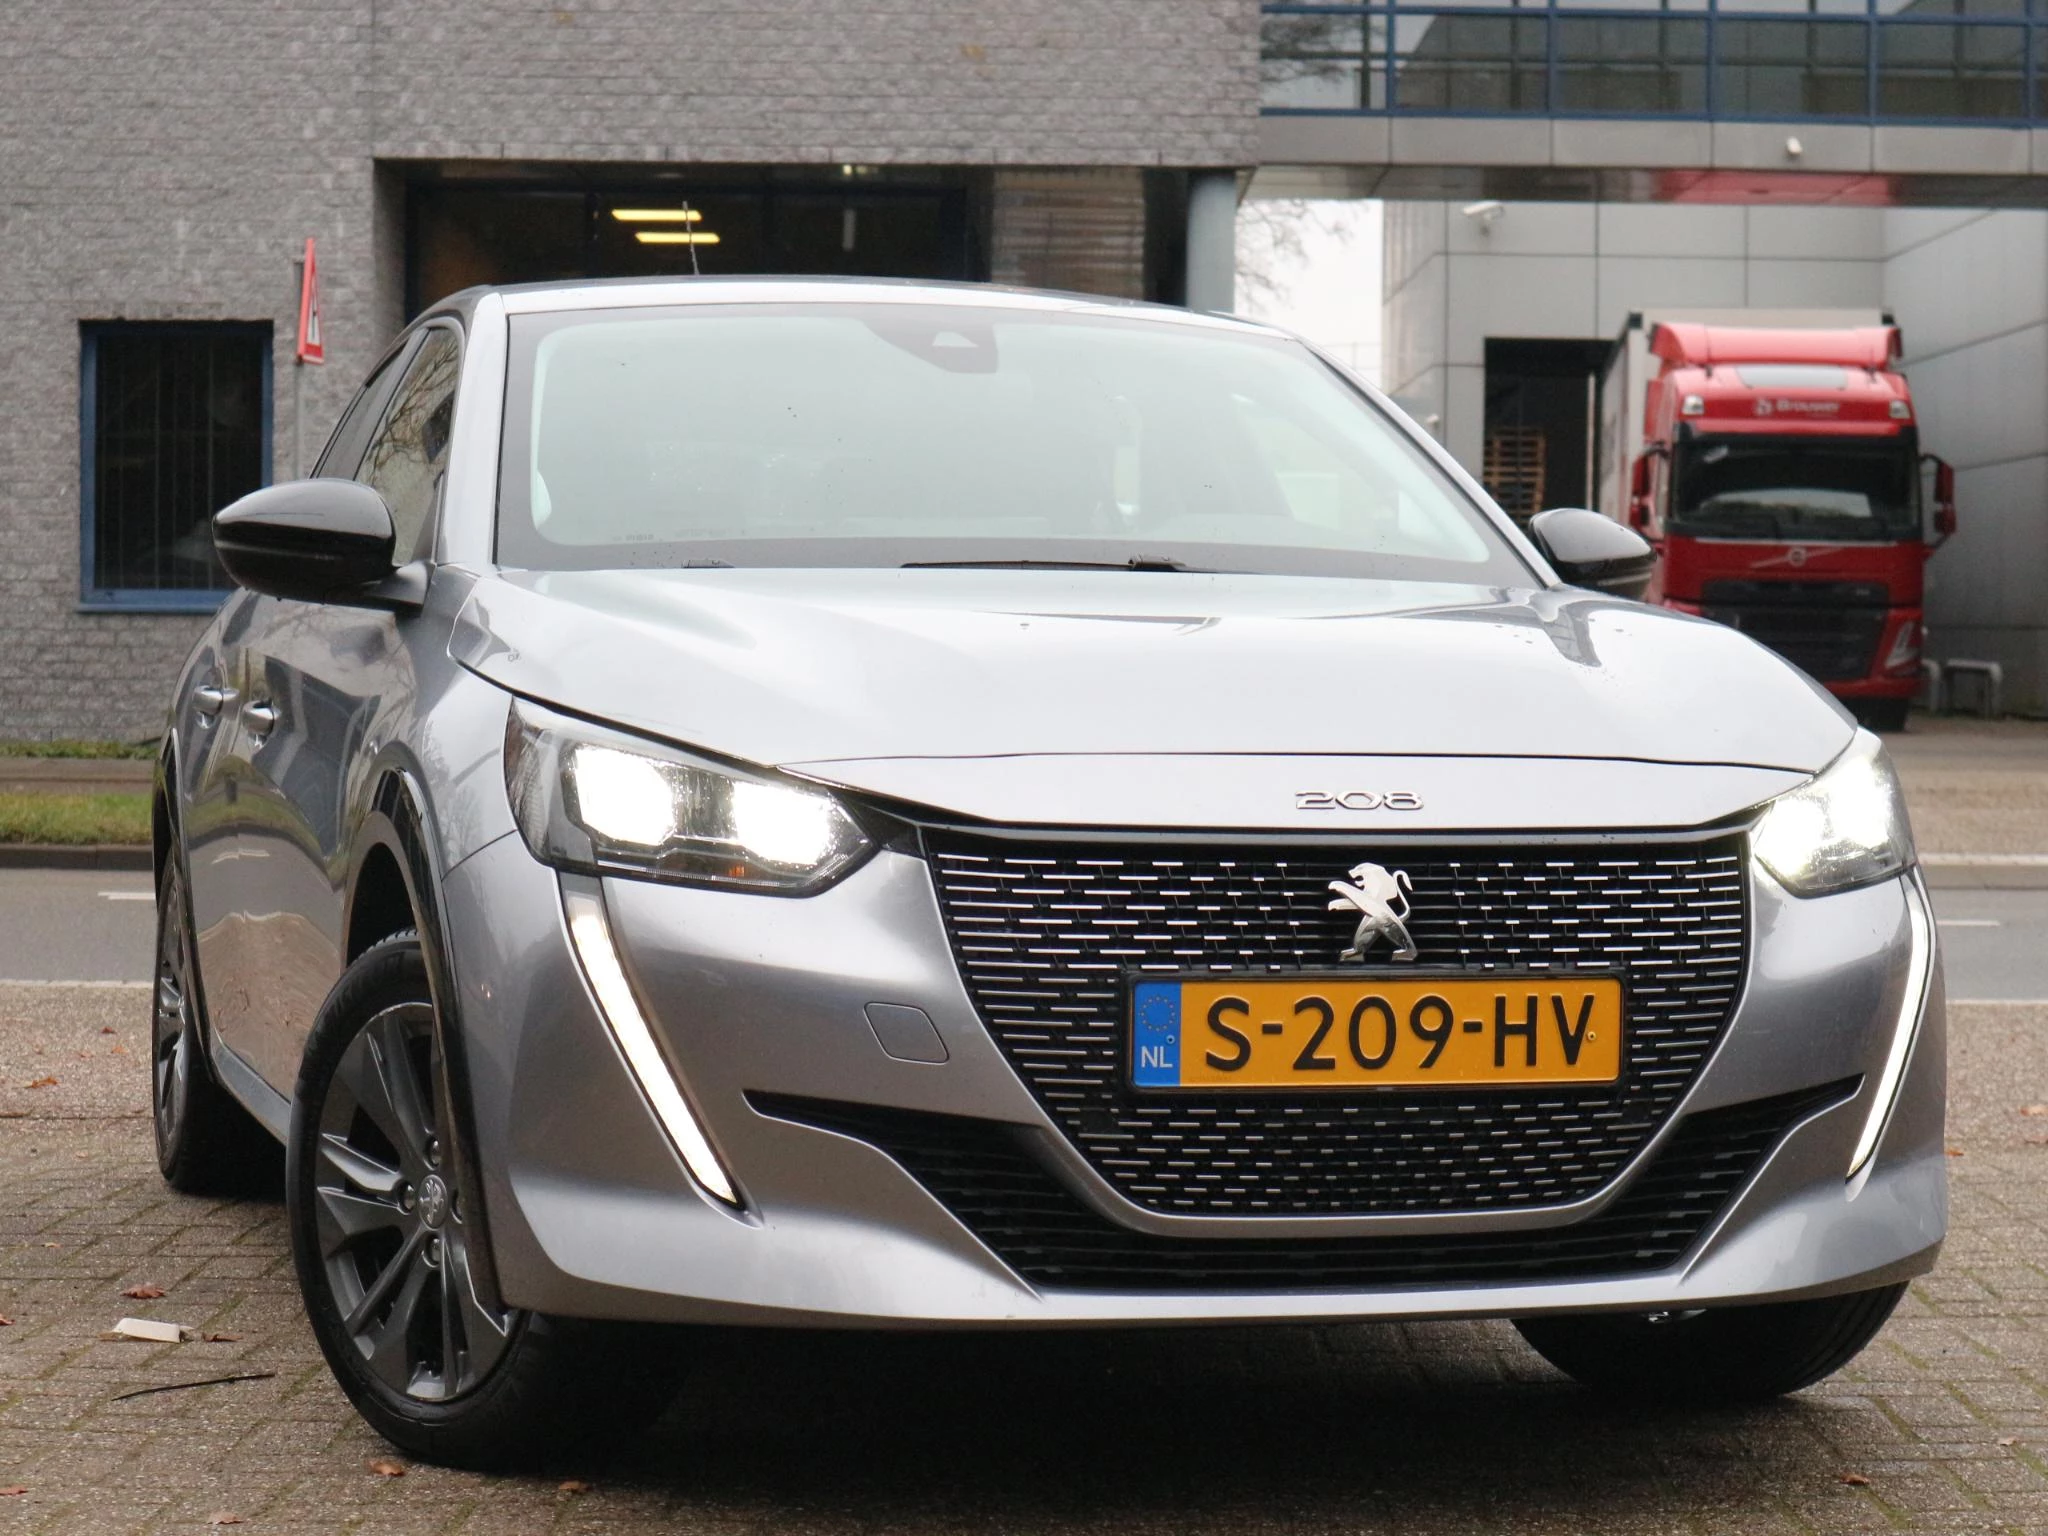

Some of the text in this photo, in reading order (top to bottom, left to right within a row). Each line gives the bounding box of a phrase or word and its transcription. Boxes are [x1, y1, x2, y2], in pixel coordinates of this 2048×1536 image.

[1295, 790, 1424, 810] 208
[1205, 994, 1595, 1071] S-209-HV
[1141, 1046, 1173, 1068] NL
